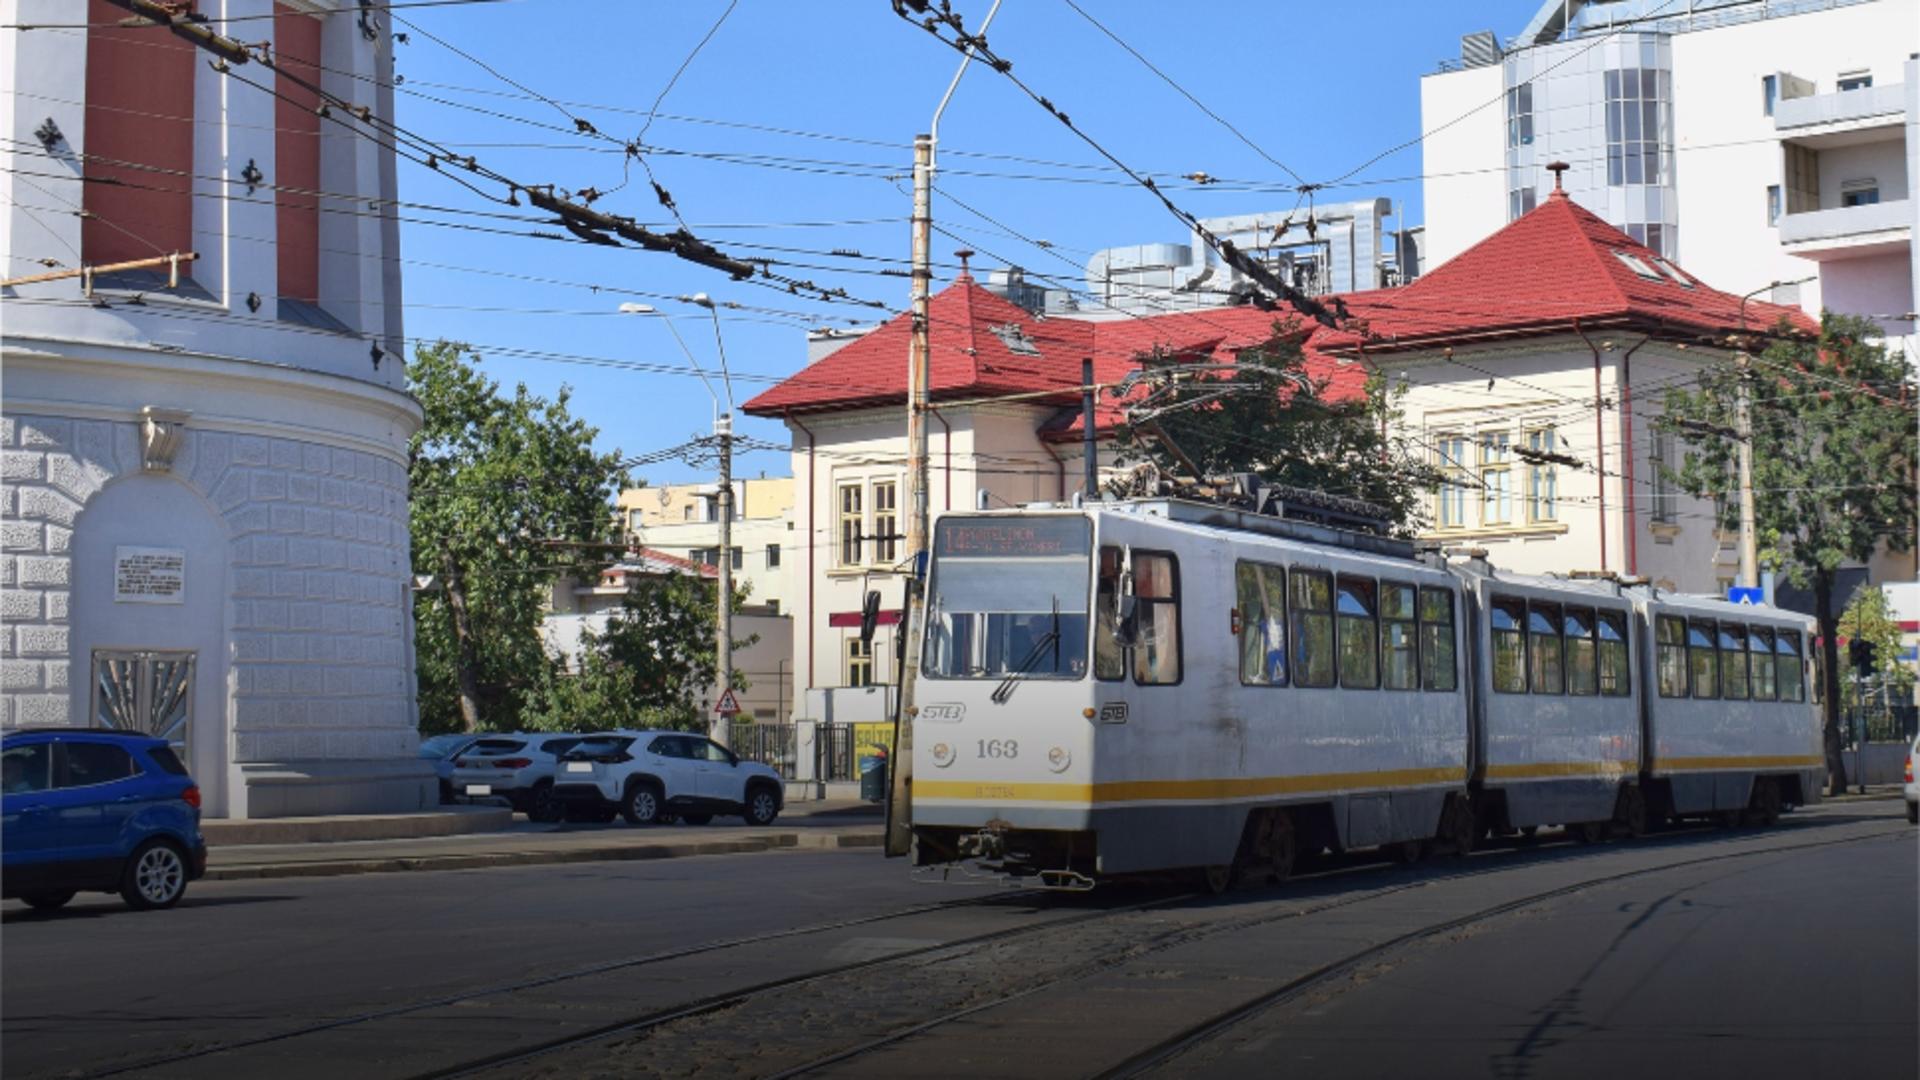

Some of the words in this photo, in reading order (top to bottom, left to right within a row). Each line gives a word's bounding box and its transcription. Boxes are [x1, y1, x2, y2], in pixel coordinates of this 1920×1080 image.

[945, 527, 963, 553] 14
[921, 704, 960, 720] STB
[1100, 704, 1125, 720] STB
[976, 738, 1019, 760] 163
